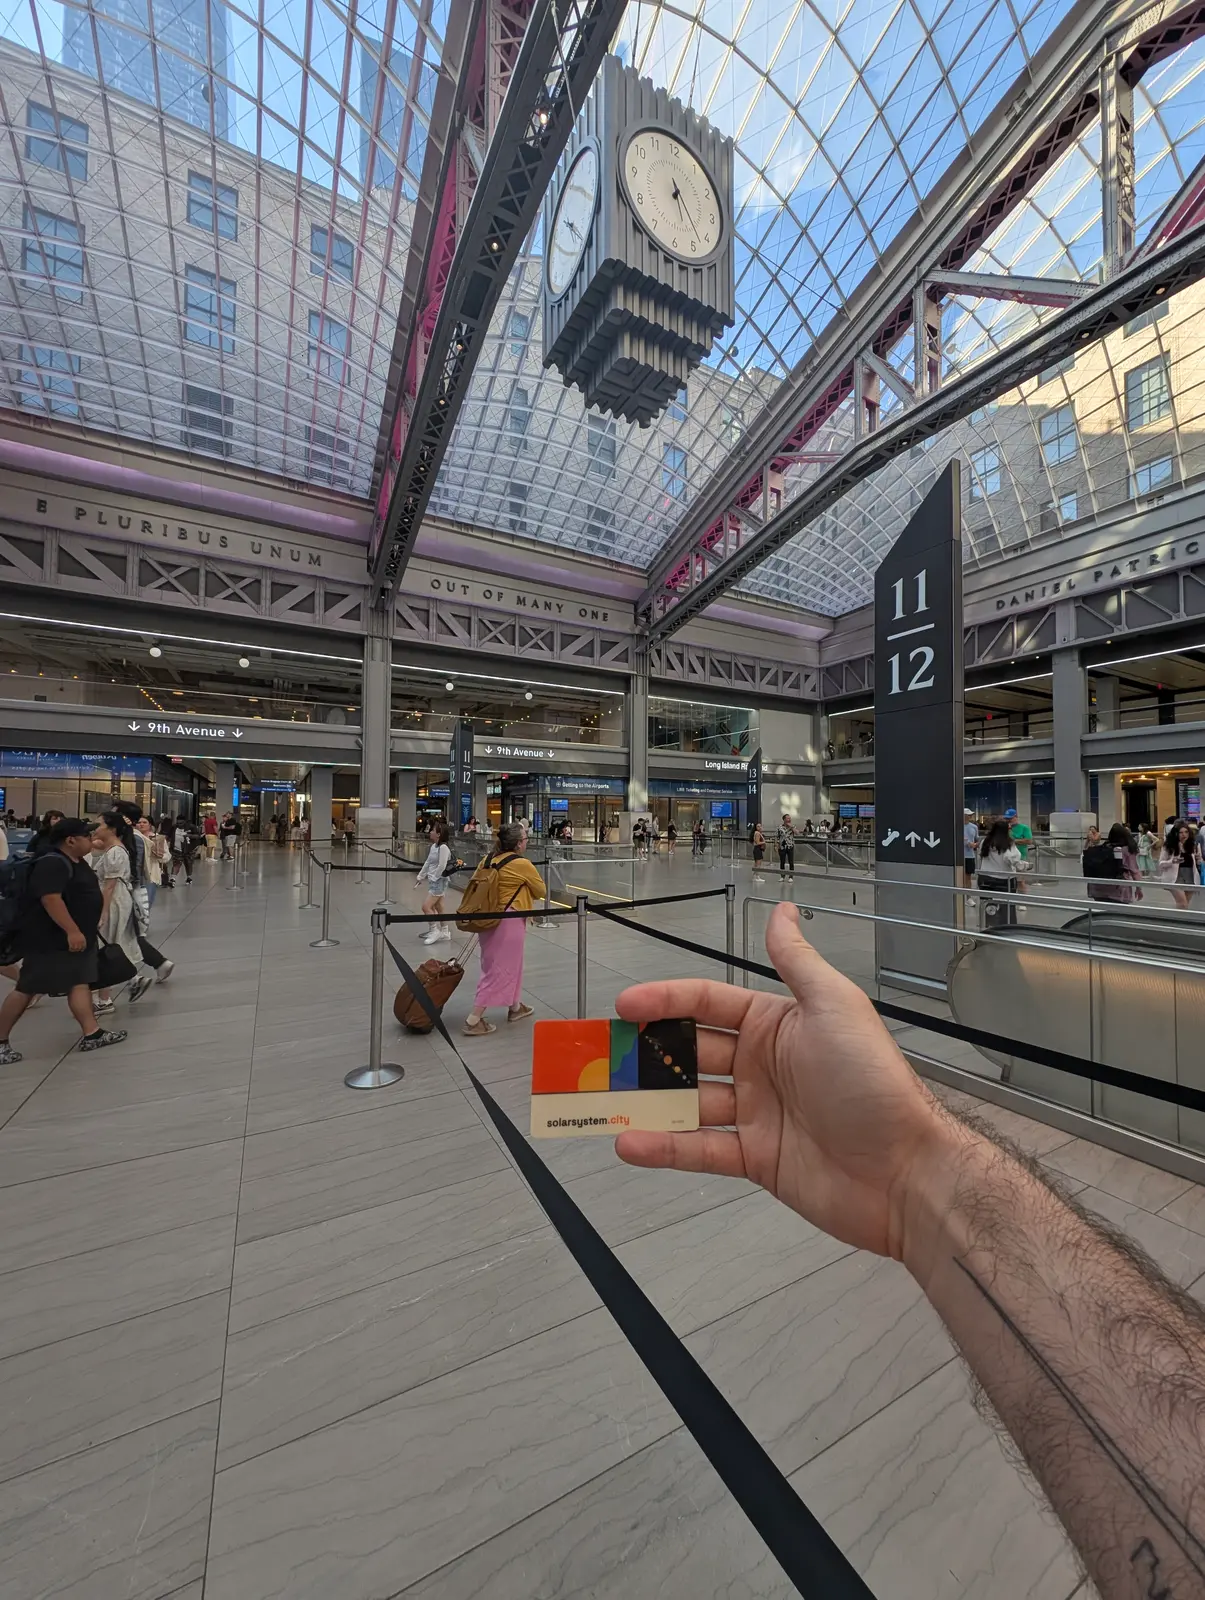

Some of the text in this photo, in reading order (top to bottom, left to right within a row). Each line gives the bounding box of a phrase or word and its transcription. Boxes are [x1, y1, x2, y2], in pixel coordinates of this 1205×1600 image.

[650, 136, 659, 151] 11
[635, 144, 646, 160] 10
[669, 143, 680, 159] 12
[631, 166, 638, 178] 9
[692, 164, 697, 175] 1
[636, 192, 644, 205] 8
[704, 188, 711, 201] 2
[652, 218, 658, 230] 7
[709, 213, 715, 225] 3
[672, 237, 678, 248] 6
[704, 232, 710, 244] 4
[690, 240, 697, 253] 5
[36, 498, 322, 567] E PLURIBUS UNUM
[430, 578, 609, 622] OUT OF MANY ONE
[891, 568, 931, 621] 11
[995, 578, 1076, 610] DANIEL
[887, 646, 935, 696] 12
[148, 722, 226, 738] 9th Avenue
[464, 750, 471, 763] 11
[496, 746, 544, 758] 9th Avenue
[705, 760, 721, 771] Long
[721, 761, 740, 770] Island
[463, 771, 471, 784] 12
[749, 768, 757, 778] 13
[748, 784, 757, 795] 14
[546, 1114, 630, 1128] solarsystem.city
